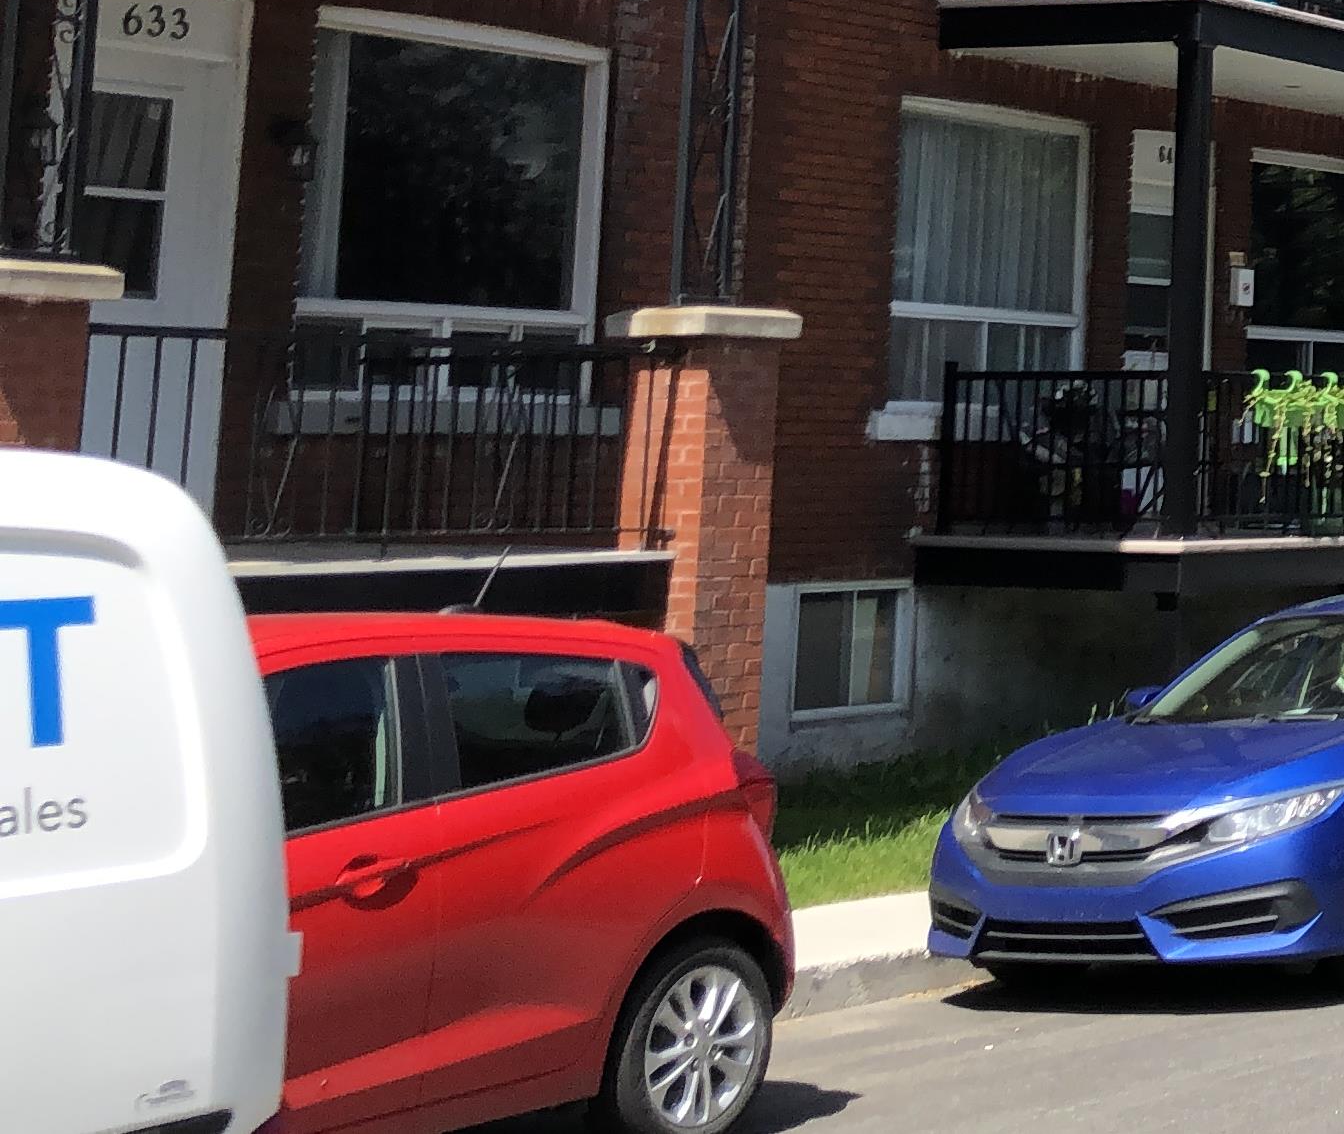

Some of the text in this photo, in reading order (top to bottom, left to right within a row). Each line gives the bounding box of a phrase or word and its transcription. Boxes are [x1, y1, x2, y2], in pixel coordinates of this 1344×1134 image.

[123, 3, 190, 40] 633
[1159, 145, 1173, 164] 64
[0, 596, 95, 747] T
